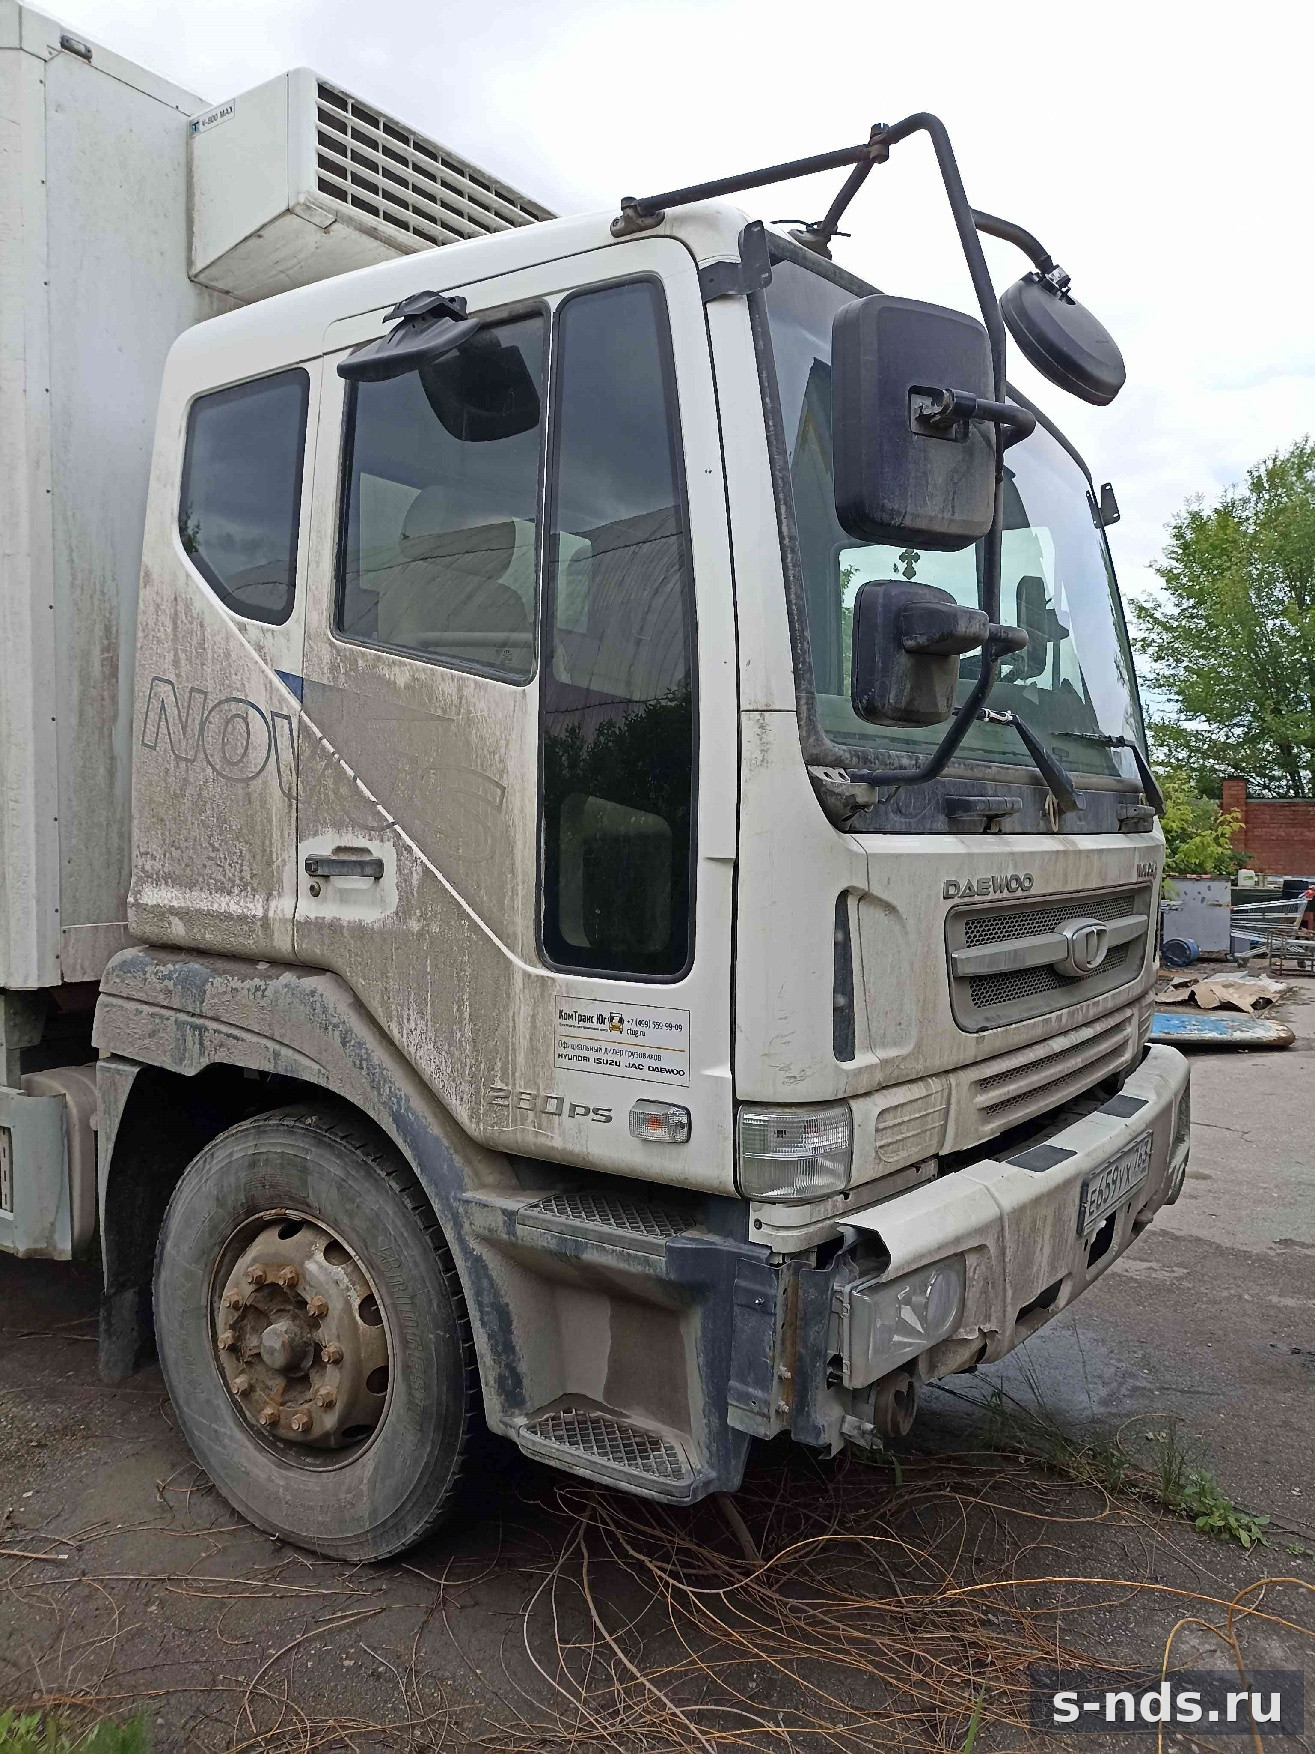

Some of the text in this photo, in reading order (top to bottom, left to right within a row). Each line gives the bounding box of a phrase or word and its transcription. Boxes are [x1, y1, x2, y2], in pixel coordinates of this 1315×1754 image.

[219, 106, 233, 119] MAX
[942, 872, 1035, 900] DAEWOO
[558, 1009, 608, 1026] КомТранс Юг
[558, 1039, 662, 1062] Официальный дилер грузовиков
[557, 1052, 686, 1077] HYUNDAI ISUZU JAC DAEWOO
